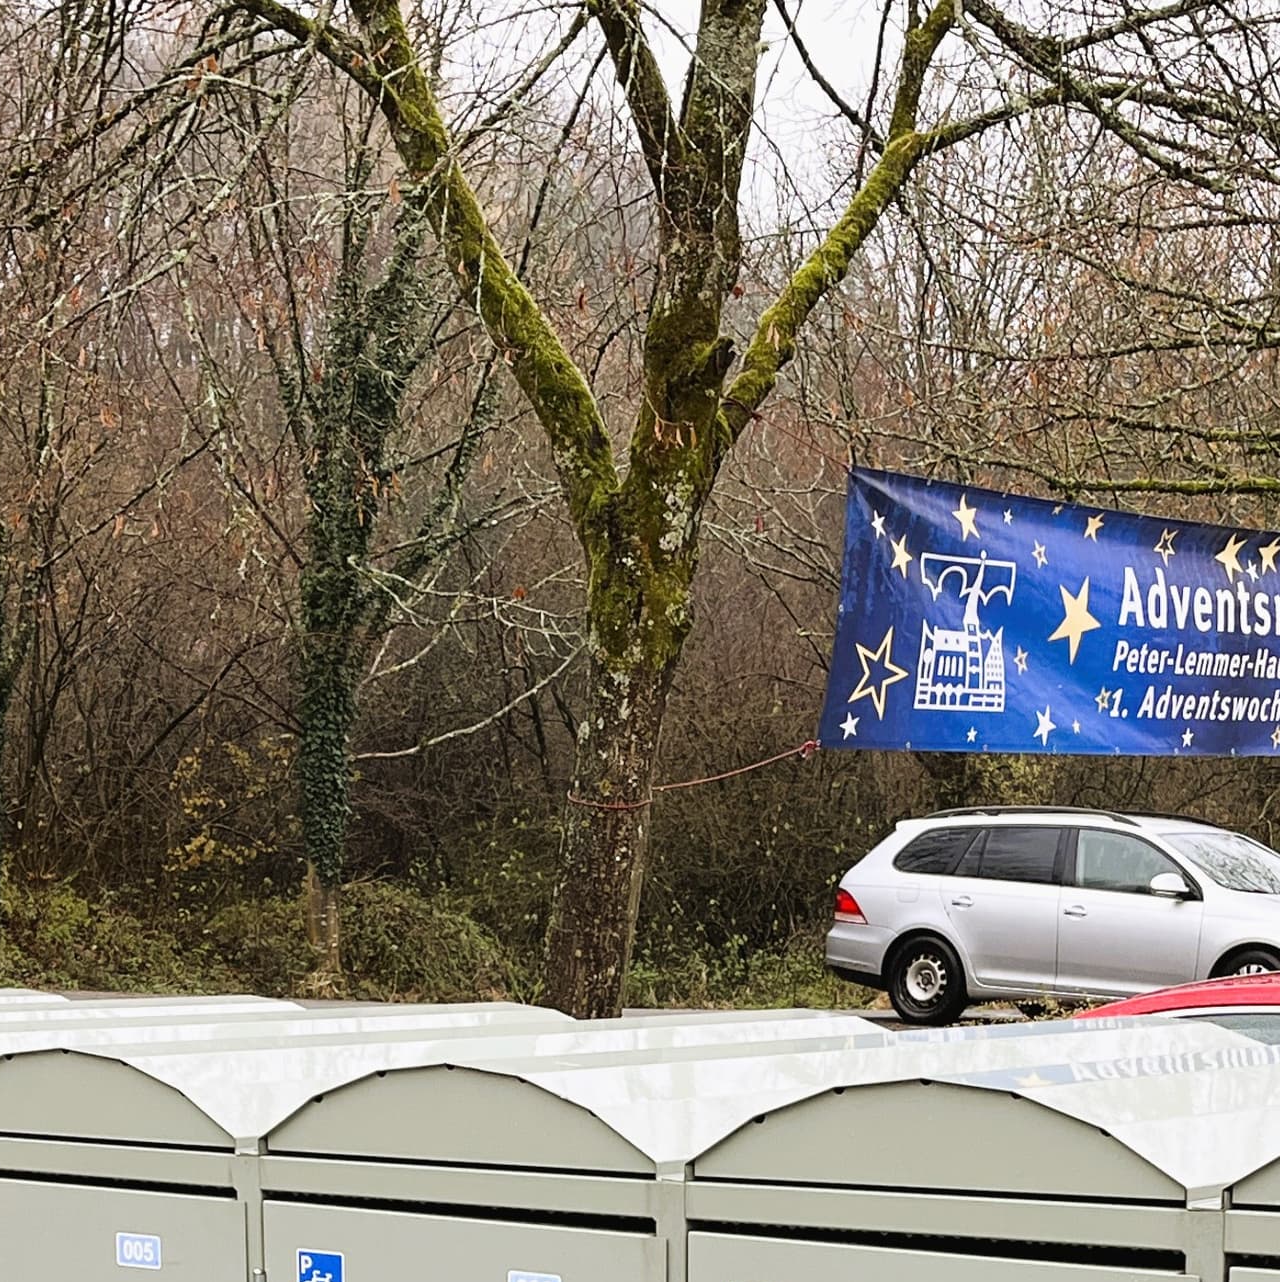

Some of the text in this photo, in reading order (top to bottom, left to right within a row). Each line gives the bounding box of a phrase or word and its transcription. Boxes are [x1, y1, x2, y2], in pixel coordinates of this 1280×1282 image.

[1108, 687, 1129, 719] 1.
[122, 1239, 155, 1262] 005
[300, 1255, 313, 1274] P
